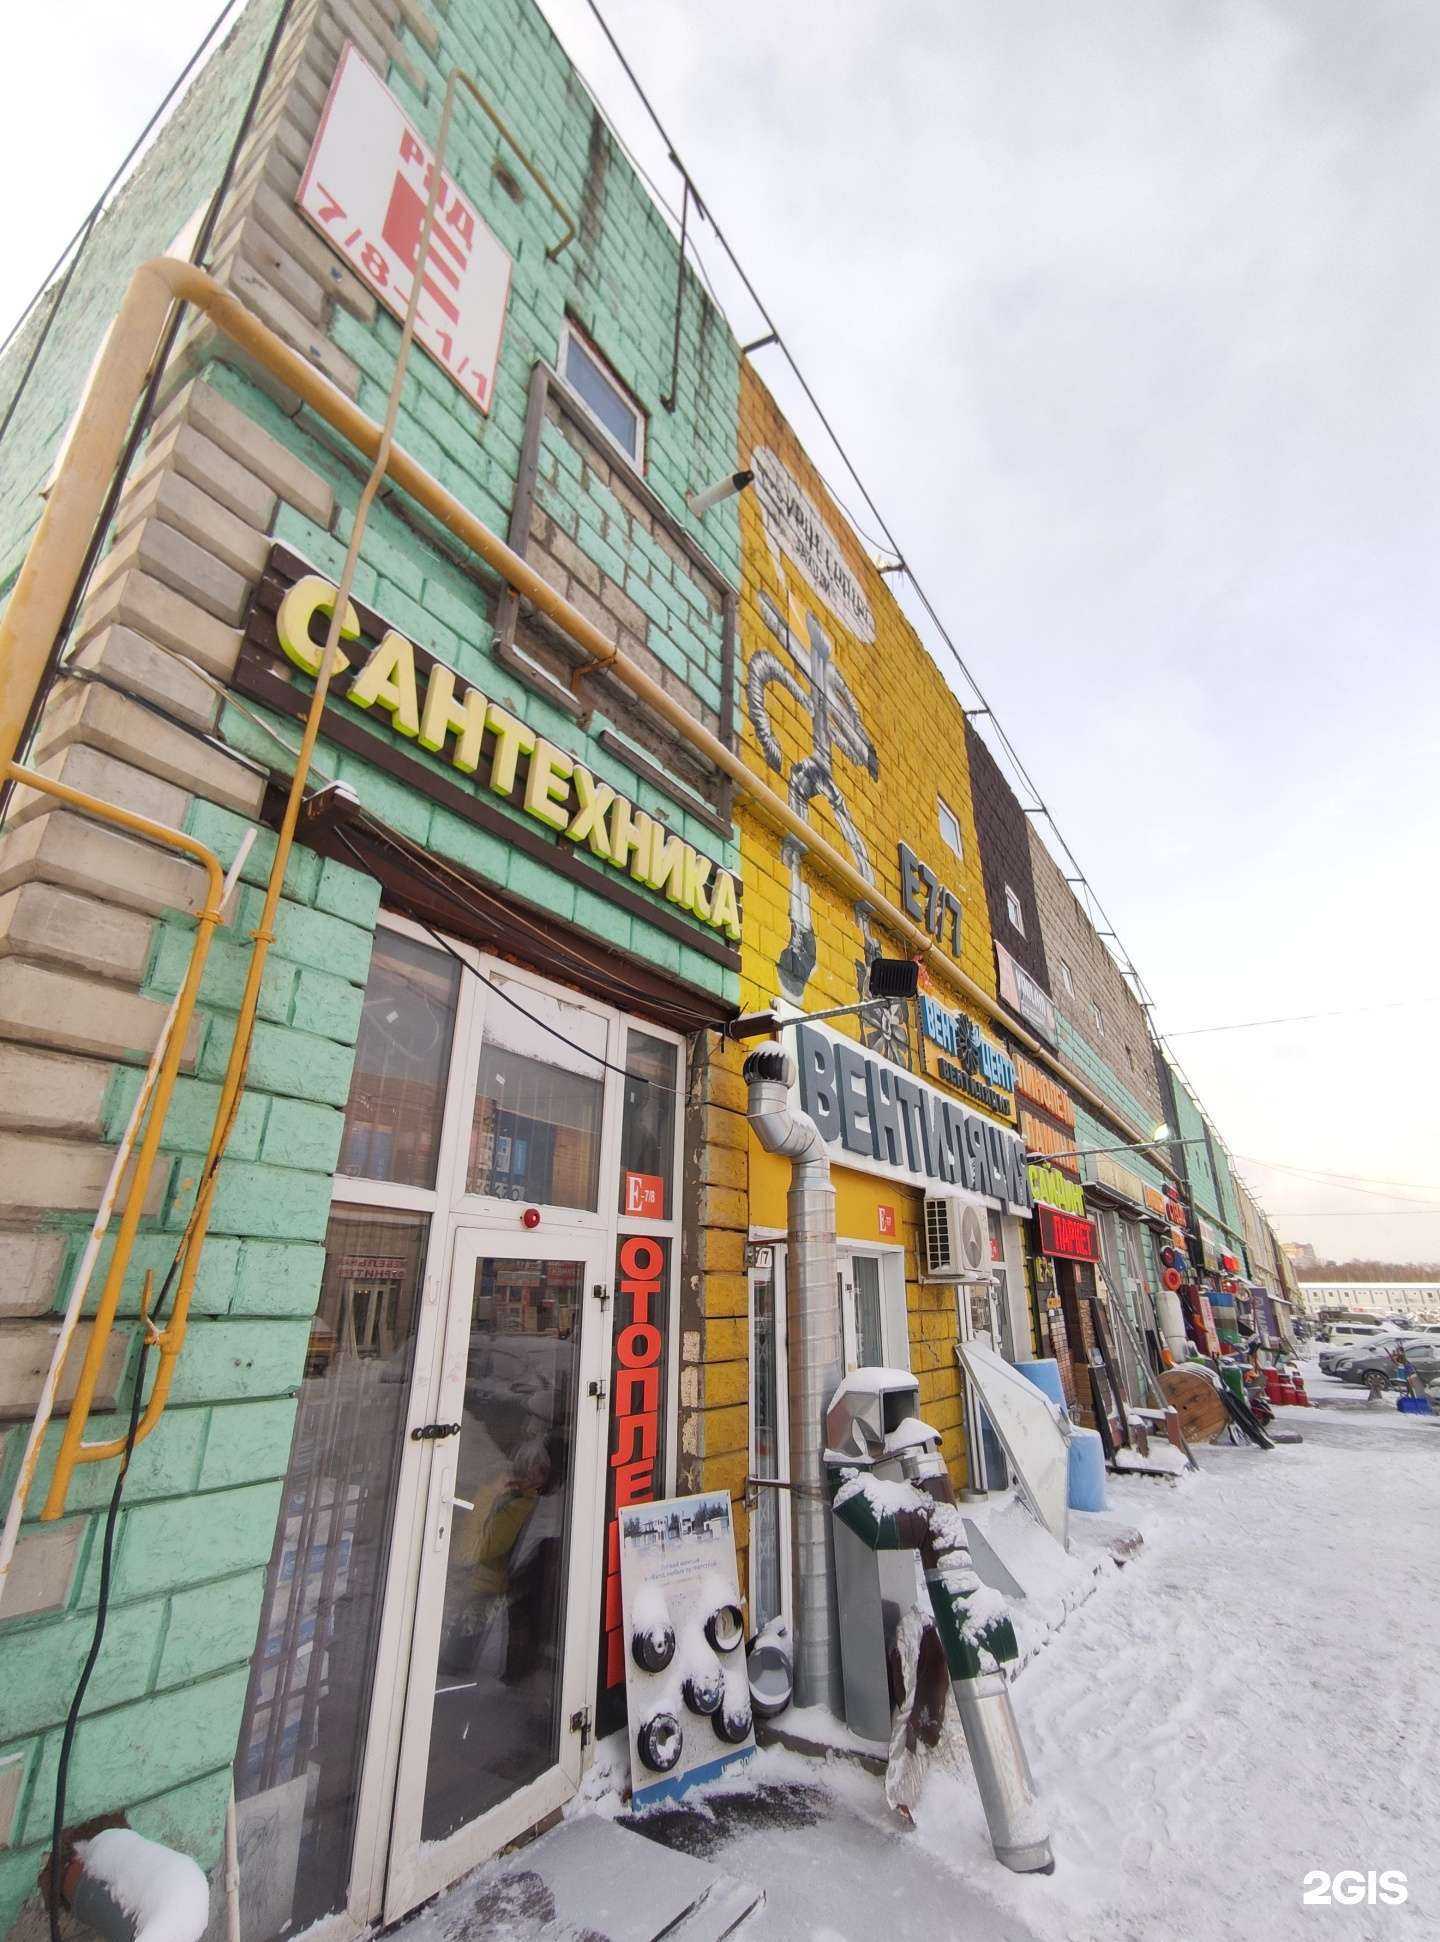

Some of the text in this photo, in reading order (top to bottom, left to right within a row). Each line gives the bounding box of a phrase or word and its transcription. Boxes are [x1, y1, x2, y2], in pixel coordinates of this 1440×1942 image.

[399, 127, 475, 254] РЯД
[277, 574, 742, 945] САНТЕХНИКА
[796, 1022, 1034, 1209] ВЕНТИЛЯЦИЯ
[606, 1237, 663, 1690] ОТОПЛЕ
